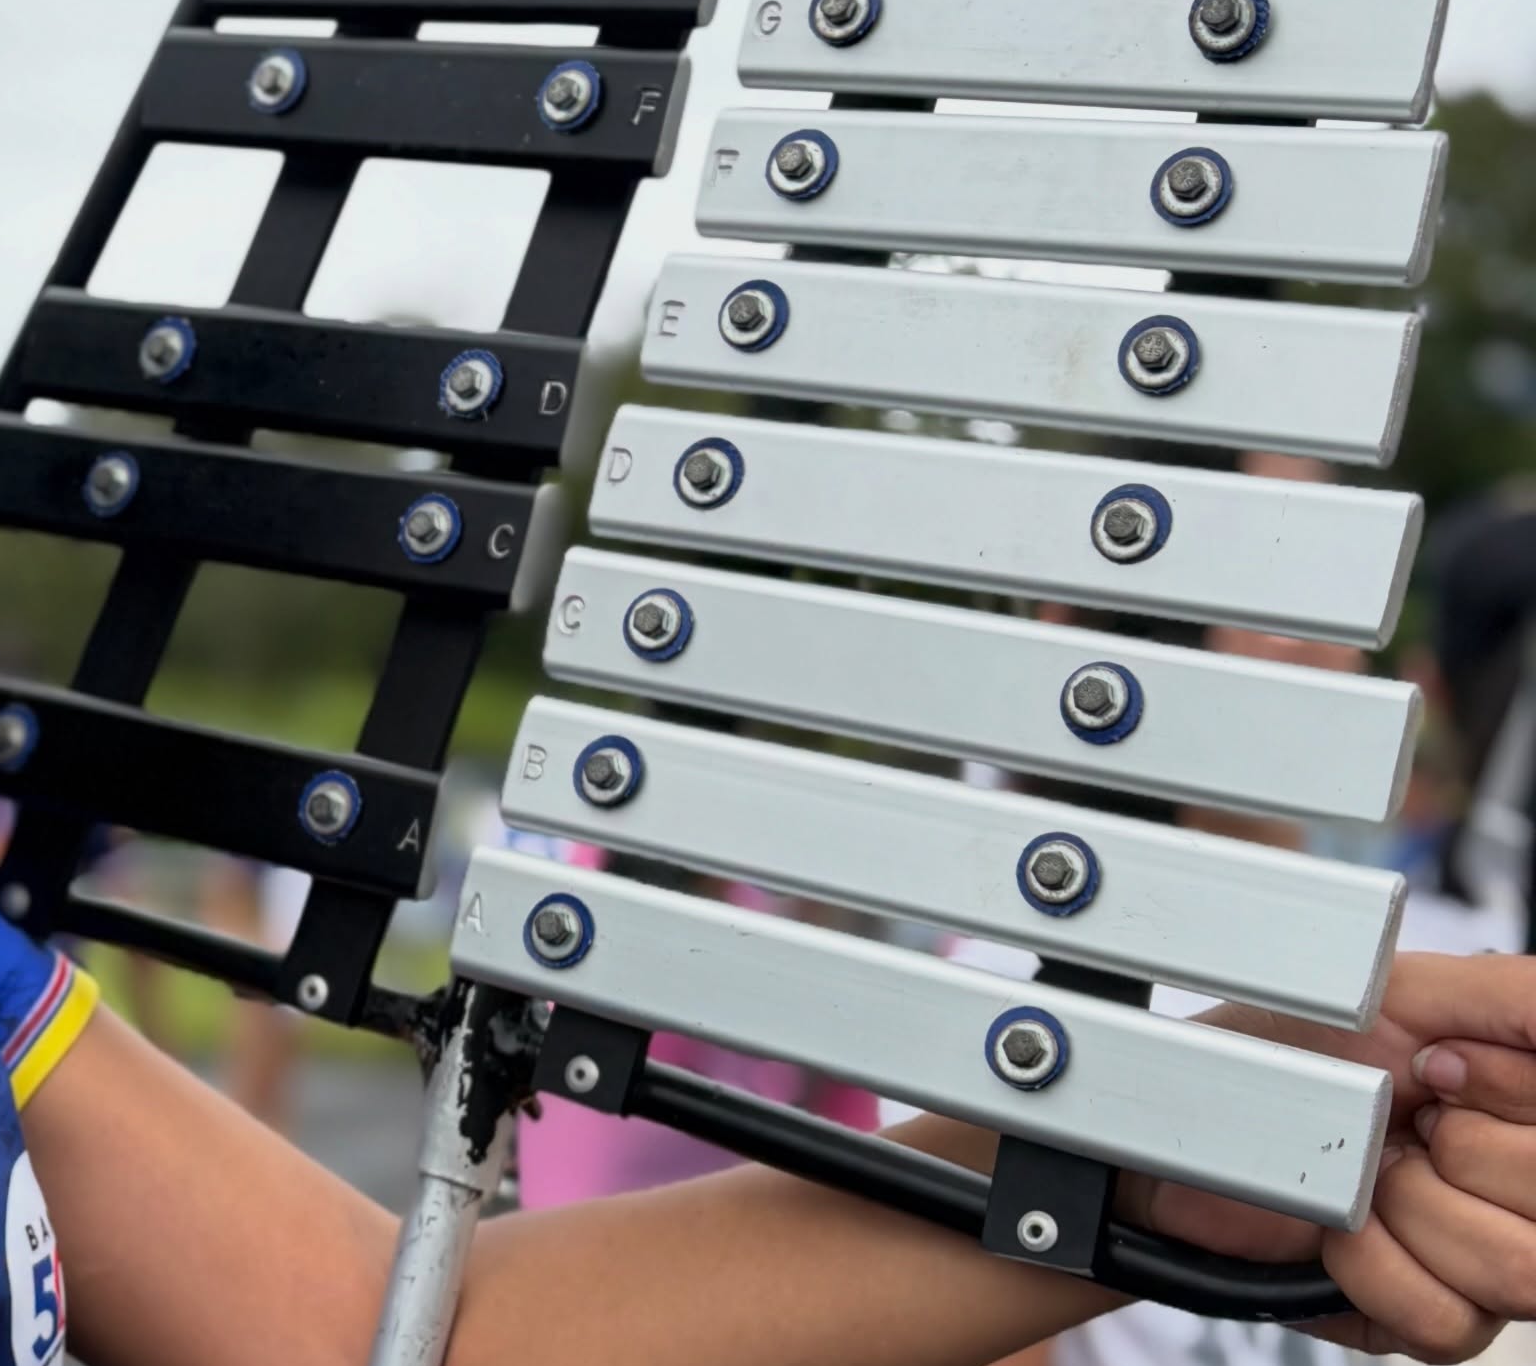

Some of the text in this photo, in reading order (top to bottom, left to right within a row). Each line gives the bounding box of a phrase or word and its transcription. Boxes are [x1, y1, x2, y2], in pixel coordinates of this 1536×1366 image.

[757, 1, 783, 36] G
[632, 87, 662, 125] F
[712, 149, 739, 186] F
[660, 300, 685, 337] E
[539, 381, 568, 415] D
[607, 447, 632, 483] D
[488, 524, 515, 559] C
[557, 596, 585, 635] C
[523, 744, 548, 781] B
[397, 819, 419, 851] A
[459, 892, 483, 932] A
